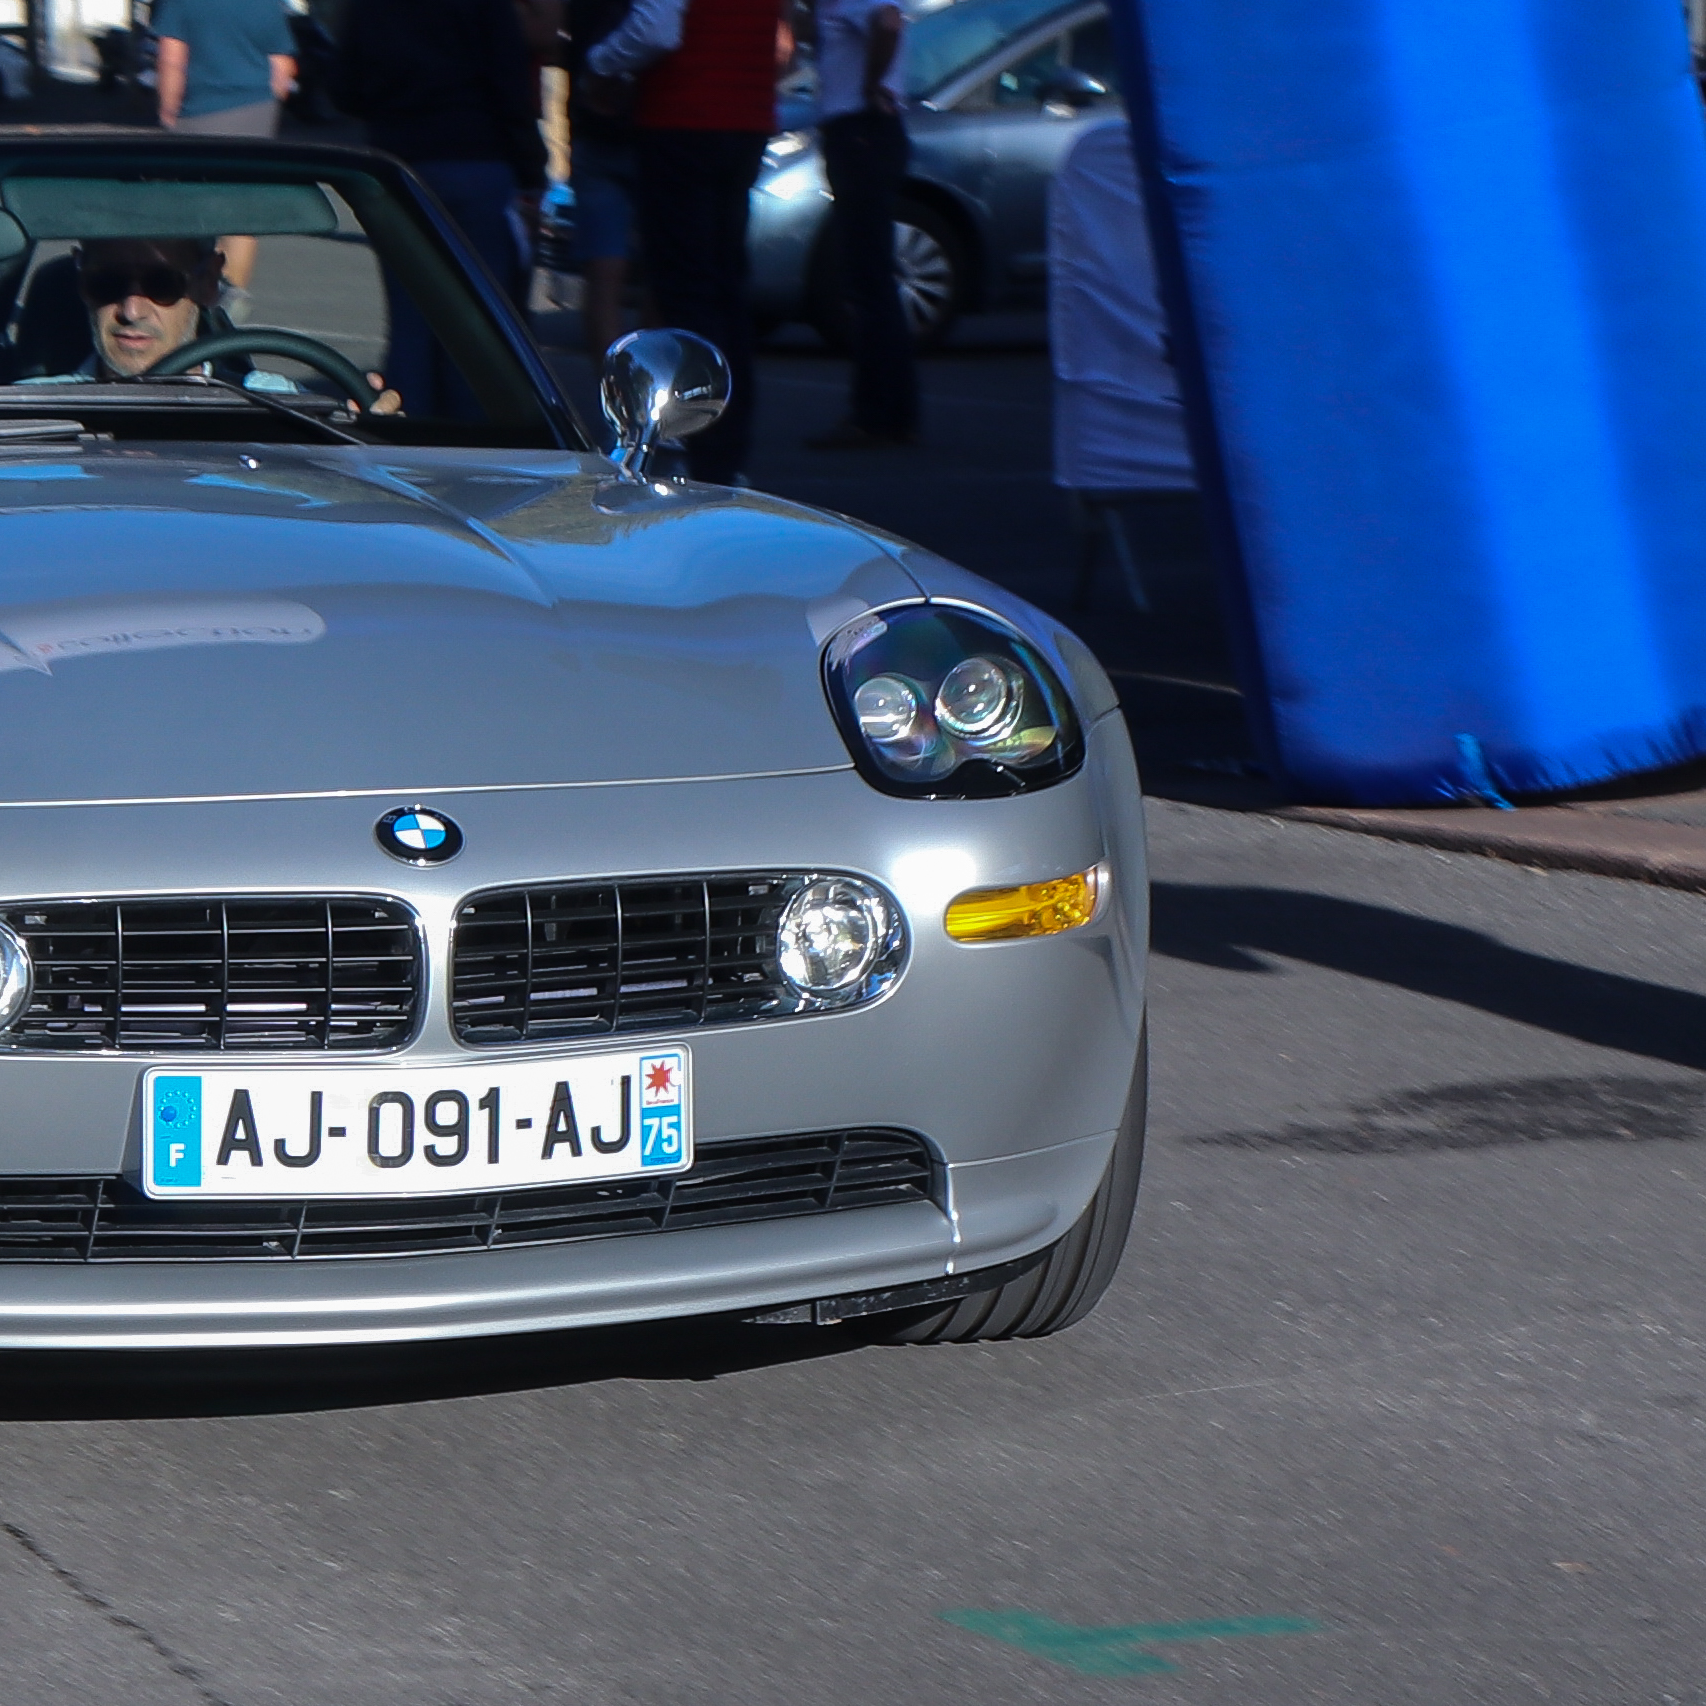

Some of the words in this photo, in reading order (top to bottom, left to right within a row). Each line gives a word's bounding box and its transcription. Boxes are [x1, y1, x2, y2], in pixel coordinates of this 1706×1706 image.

[215, 1074, 632, 1169] AJ-091-AJ
[642, 1115, 679, 1157] 75
[168, 1142, 187, 1168] F
